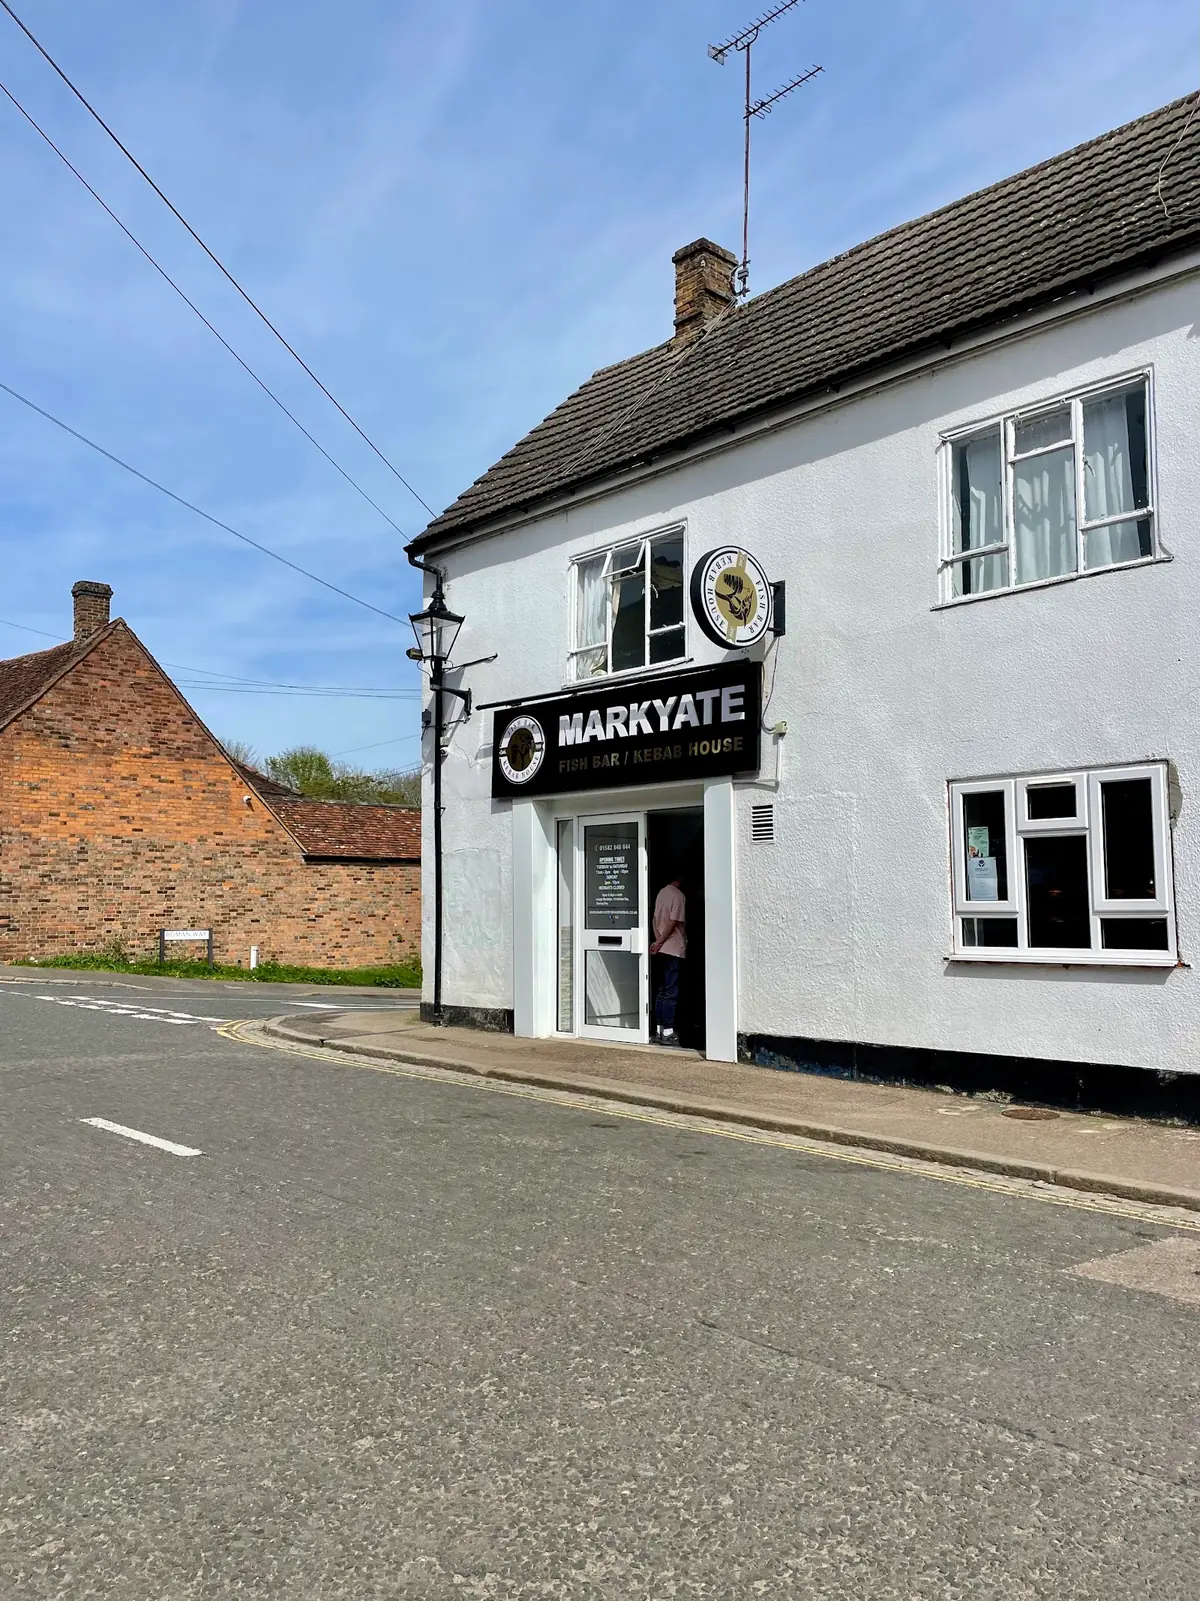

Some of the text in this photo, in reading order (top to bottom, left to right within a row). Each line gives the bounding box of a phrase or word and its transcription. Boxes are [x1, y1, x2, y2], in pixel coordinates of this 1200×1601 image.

[706, 555, 733, 629] KEBAB HOUSE
[748, 580, 766, 635] FISH BAR
[558, 684, 746, 747] MARKYATE
[503, 757, 539, 779] KEBAB HOUSE
[559, 756, 588, 773] FISH
[592, 752, 620, 769] BAR
[633, 744, 683, 764] KEBAB
[688, 736, 744, 757] HOUSE
